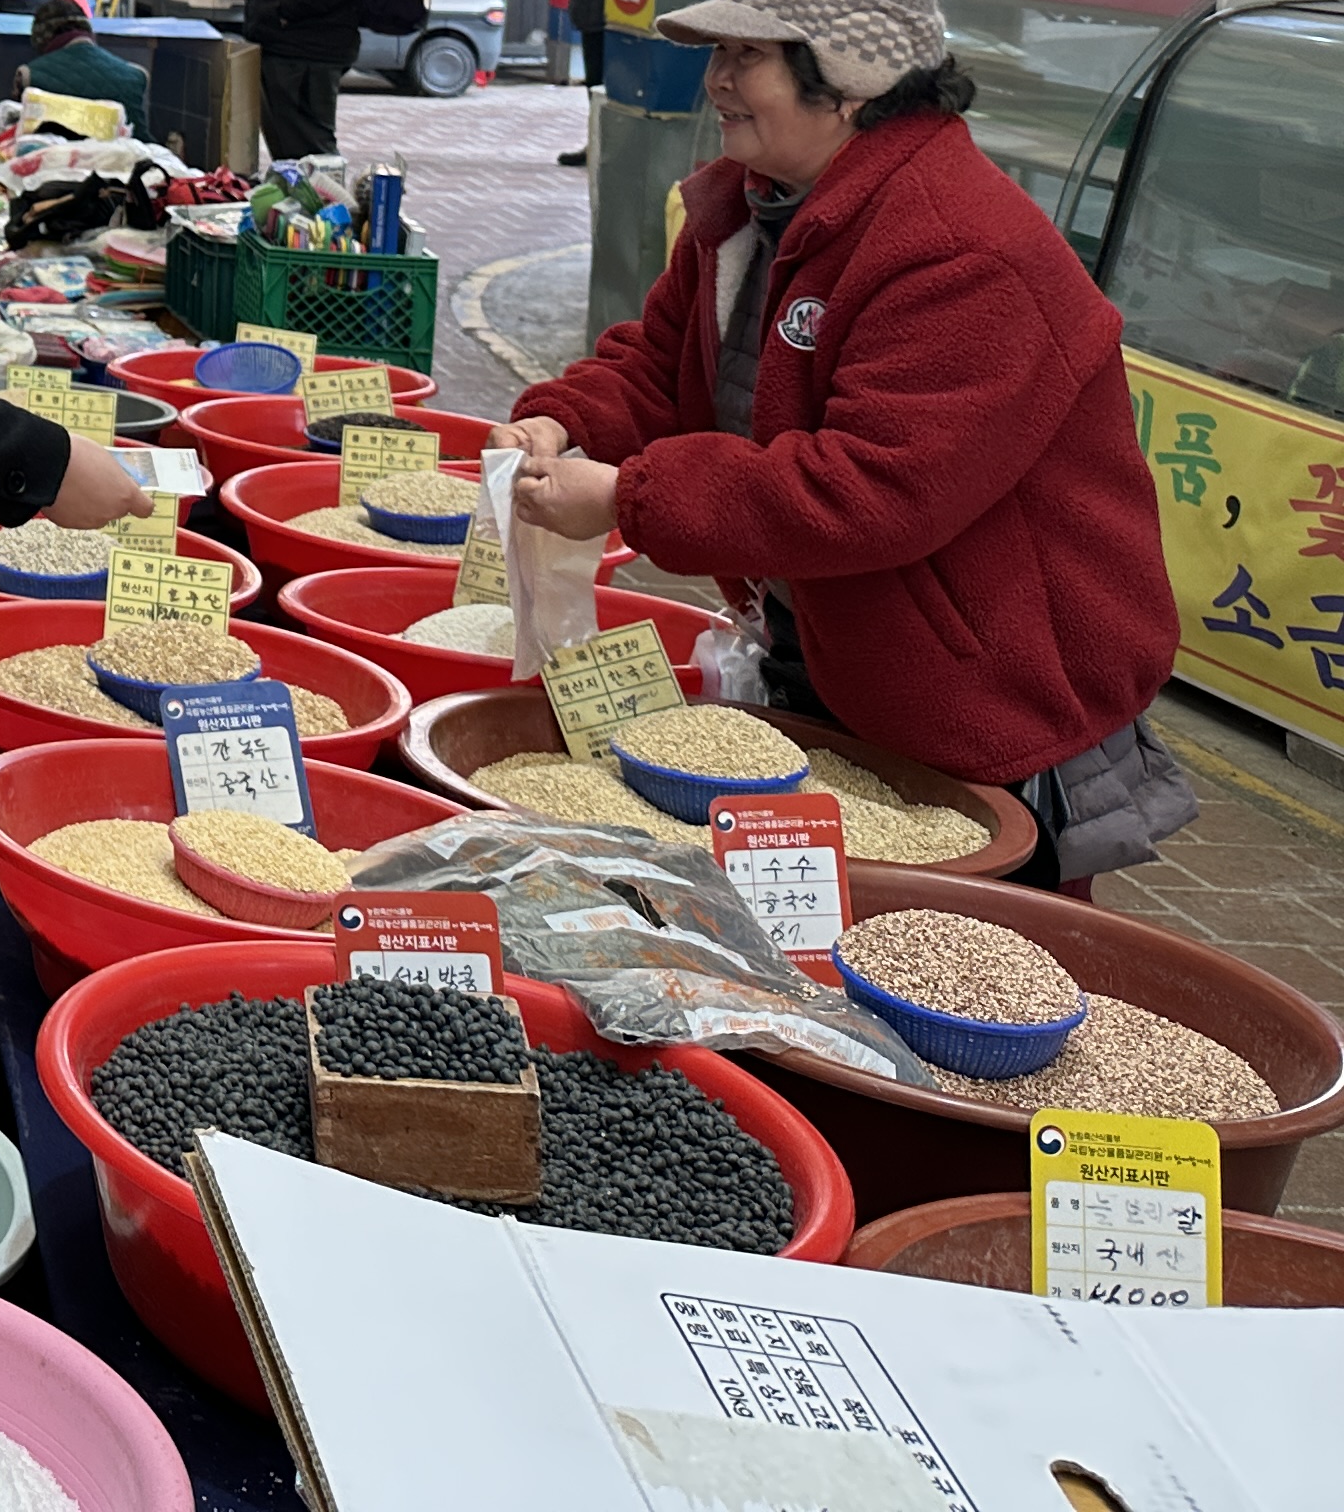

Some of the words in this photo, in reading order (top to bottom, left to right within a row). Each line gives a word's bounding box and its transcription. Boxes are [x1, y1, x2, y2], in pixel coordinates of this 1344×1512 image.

[120, 580, 153, 595] 원산지
[558, 676, 599, 700] 원산지
[198, 715, 262, 731] 원산지표시판
[747, 833, 810, 848] 원산지표시판
[762, 855, 817, 882] 수수
[378, 934, 458, 951] 원산지표시판
[1069, 1144, 1163, 1162] 국립농산물품질관리원
[1080, 1163, 1170, 1187] 원산지표시판
[1050, 1197, 1080, 1210] 품명
[1051, 1241, 1081, 1255] 원산지
[1096, 1238, 1186, 1272] 국내산
[712, 1307, 752, 1346] 등급
[751, 1314, 790, 1351] 산지
[674, 1301, 713, 1340] 중량
[719, 1378, 755, 1418] 10kg
